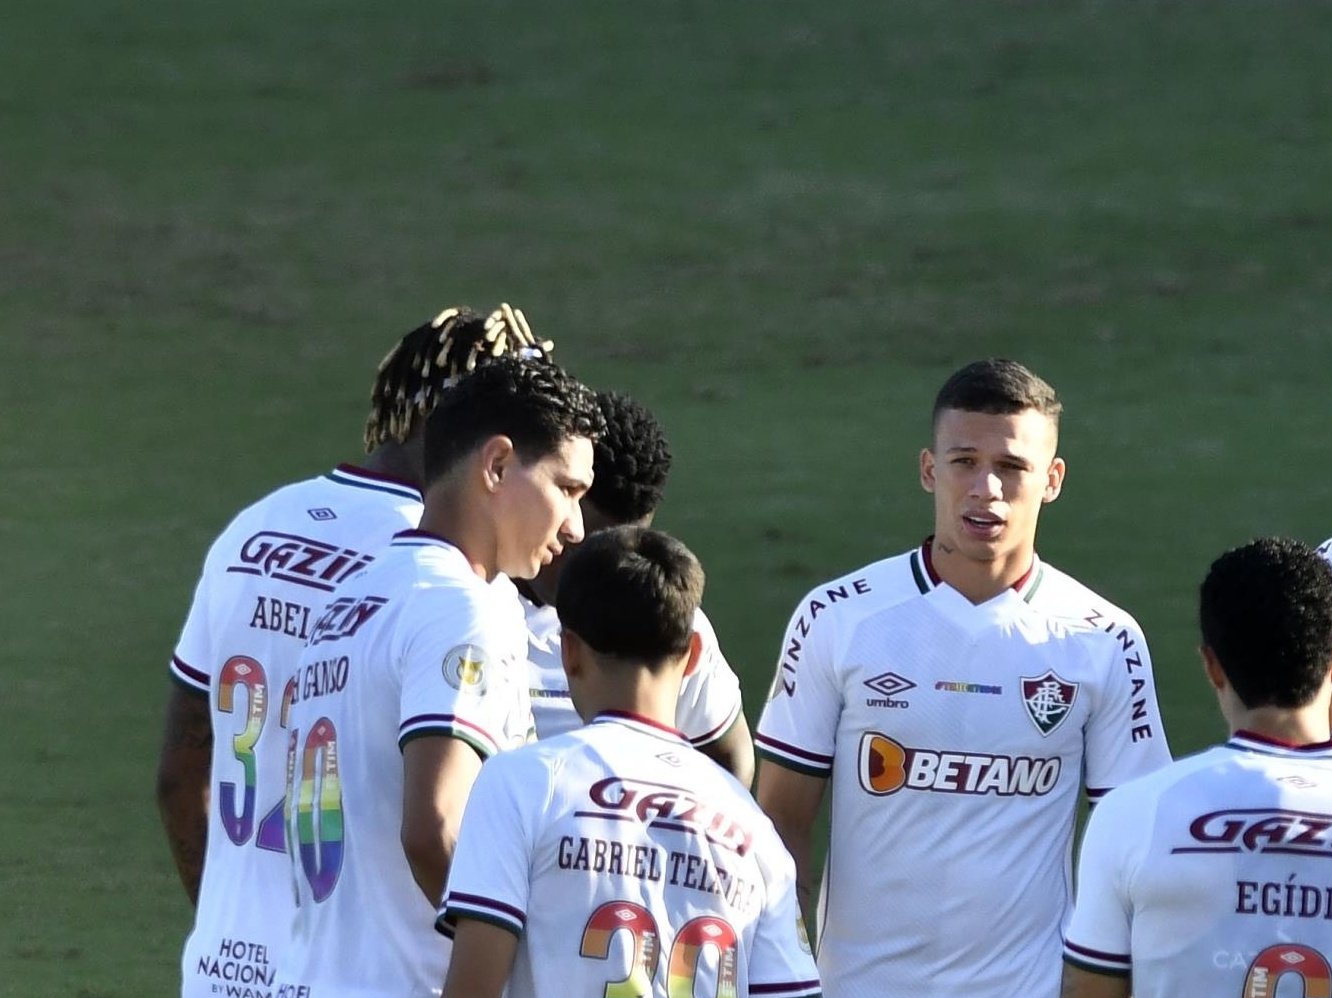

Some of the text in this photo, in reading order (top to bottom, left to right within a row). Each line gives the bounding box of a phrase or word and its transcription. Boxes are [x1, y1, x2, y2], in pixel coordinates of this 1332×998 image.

[782, 578, 872, 697] ZINZANE
[1084, 608, 1153, 743] ZINZANE
[866, 698, 909, 709] umbro
[907, 751, 1061, 795] BETANO
[588, 777, 752, 857] GAZIN
[558, 836, 661, 882] GABRIEL
[219, 938, 269, 964] HOTEL
[211, 984, 224, 994] BY
